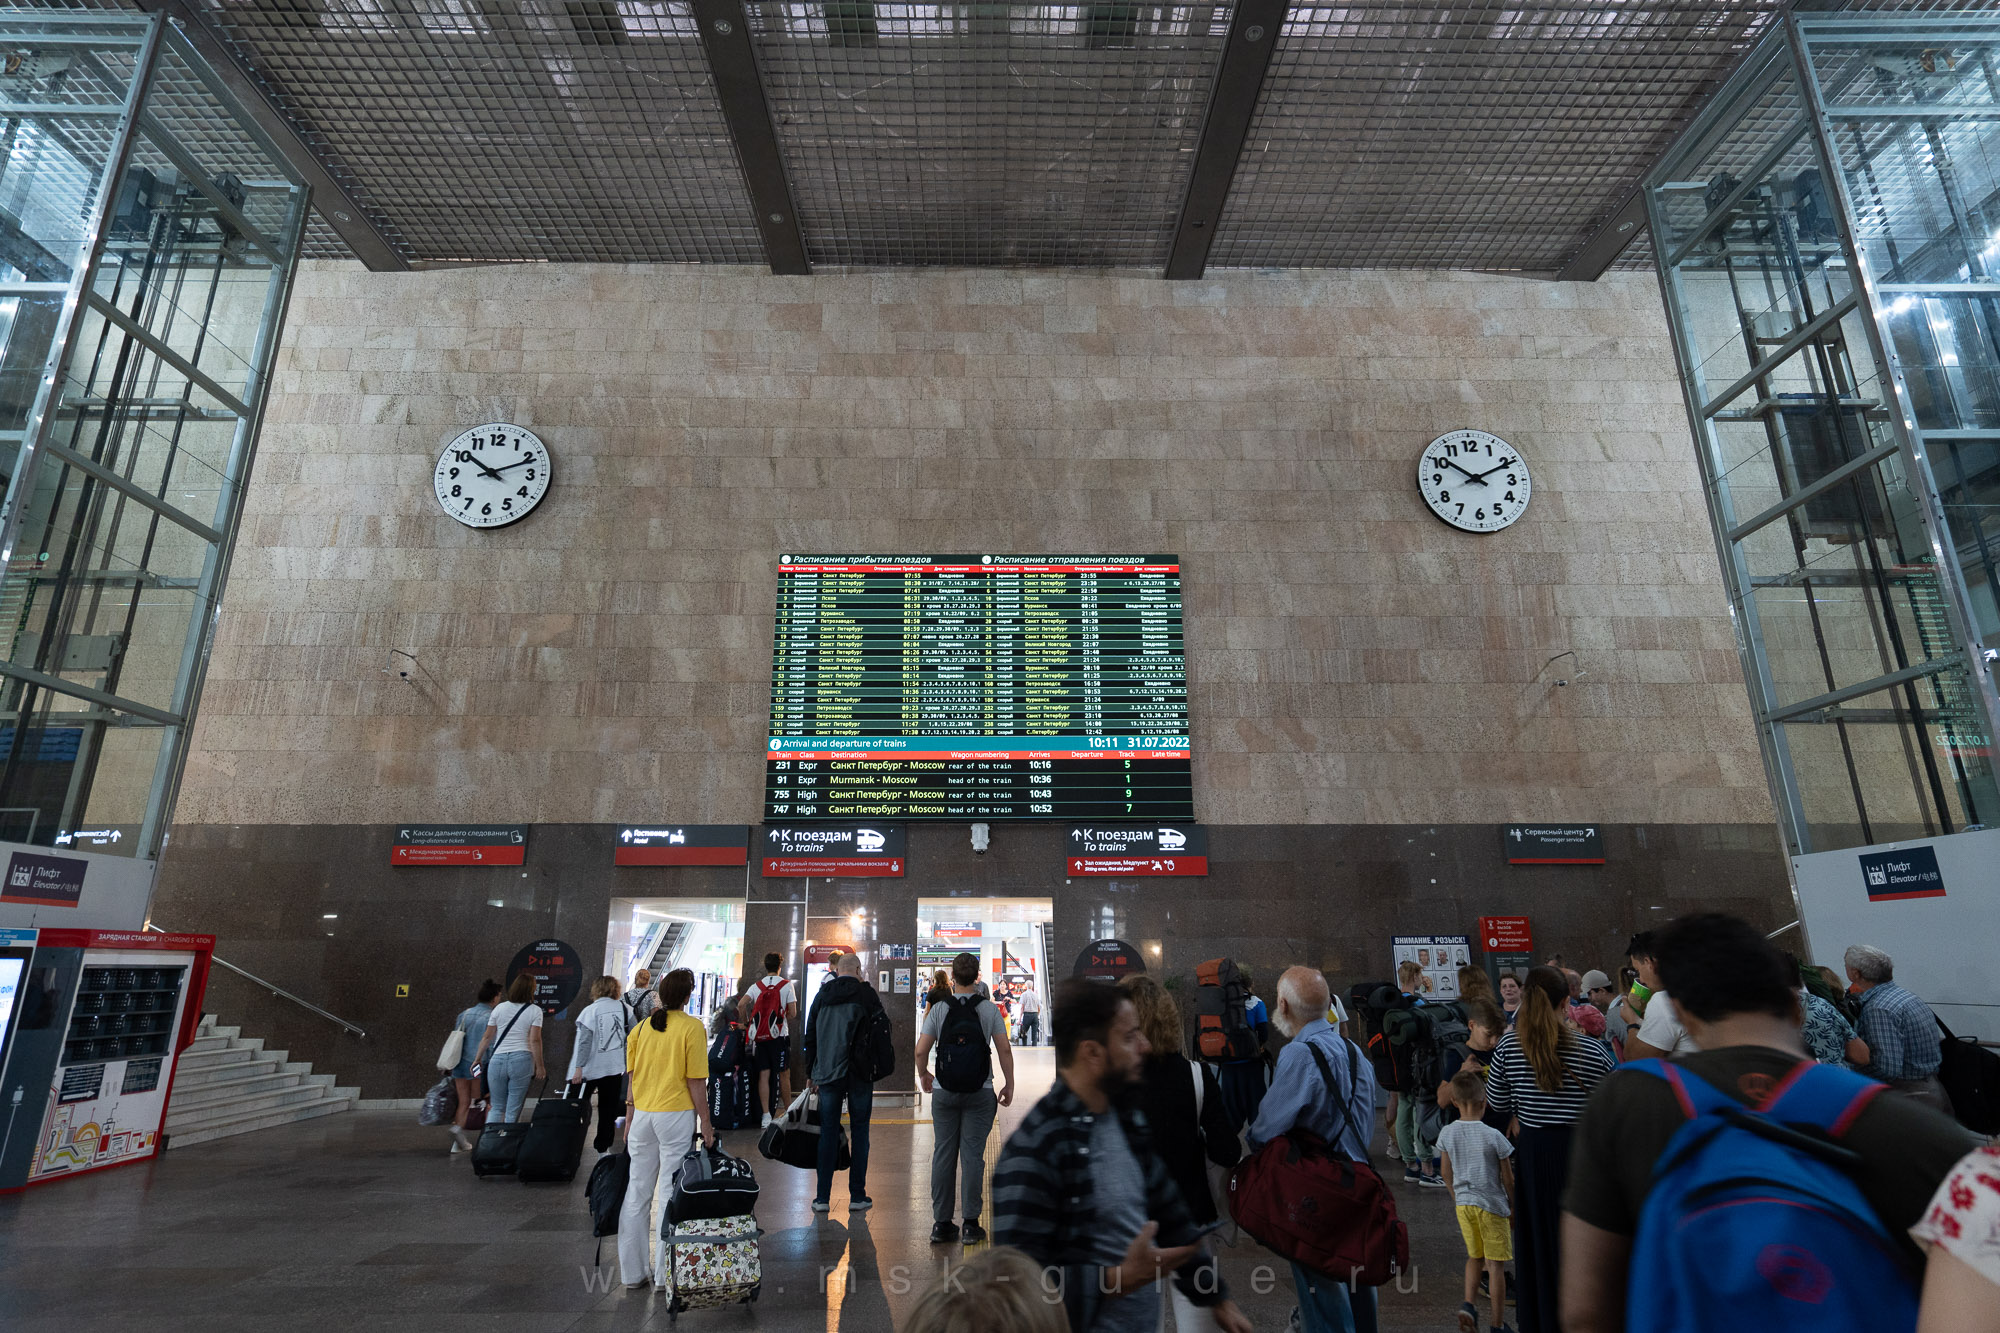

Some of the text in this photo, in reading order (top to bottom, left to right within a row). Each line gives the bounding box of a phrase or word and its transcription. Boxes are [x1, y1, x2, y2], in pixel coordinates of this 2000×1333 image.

[472, 438, 484, 450] 11
[490, 434, 506, 446] 12
[514, 439, 520, 450] 1
[1445, 445, 1458, 456] 11
[1462, 441, 1478, 452] 12
[1485, 445, 1493, 456] 1
[455, 451, 471, 462] 10
[524, 452, 533, 463] 2
[1433, 458, 1449, 469] 10
[1499, 457, 1509, 468] 2
[450, 467, 459, 479] 9
[526, 469, 535, 480] 3
[1433, 474, 1442, 485] 9
[1507, 474, 1517, 485] 3
[451, 485, 462, 497] 8
[517, 486, 528, 498] 4
[1440, 491, 1450, 502] 8
[1504, 491, 1515, 503] 4
[464, 498, 474, 510] 7
[482, 503, 491, 515] 6
[501, 498, 512, 510] 5
[1455, 503, 1464, 515] 7
[1493, 503, 1502, 515] 5
[1475, 508, 1485, 520] 6
[848, 556, 892, 564] прибытия
[830, 740, 870, 748] departure
[1089, 738, 1189, 748] 10:11 31.07.2022
[799, 762, 817, 771] Expr
[858, 762, 902, 771] Петербург
[798, 777, 817, 785] Expr
[798, 791, 817, 800] High
[857, 791, 901, 800] Петербург
[797, 806, 816, 815] High
[856, 806, 901, 815] Петербург
[782, 830, 851, 842] К поездам
[1084, 829, 1153, 842] К поездам
[781, 843, 824, 852] To trains
[1084, 842, 1126, 851] To trains
[1887, 862, 1911, 872] Лифт
[36, 867, 61, 879] Лифт
